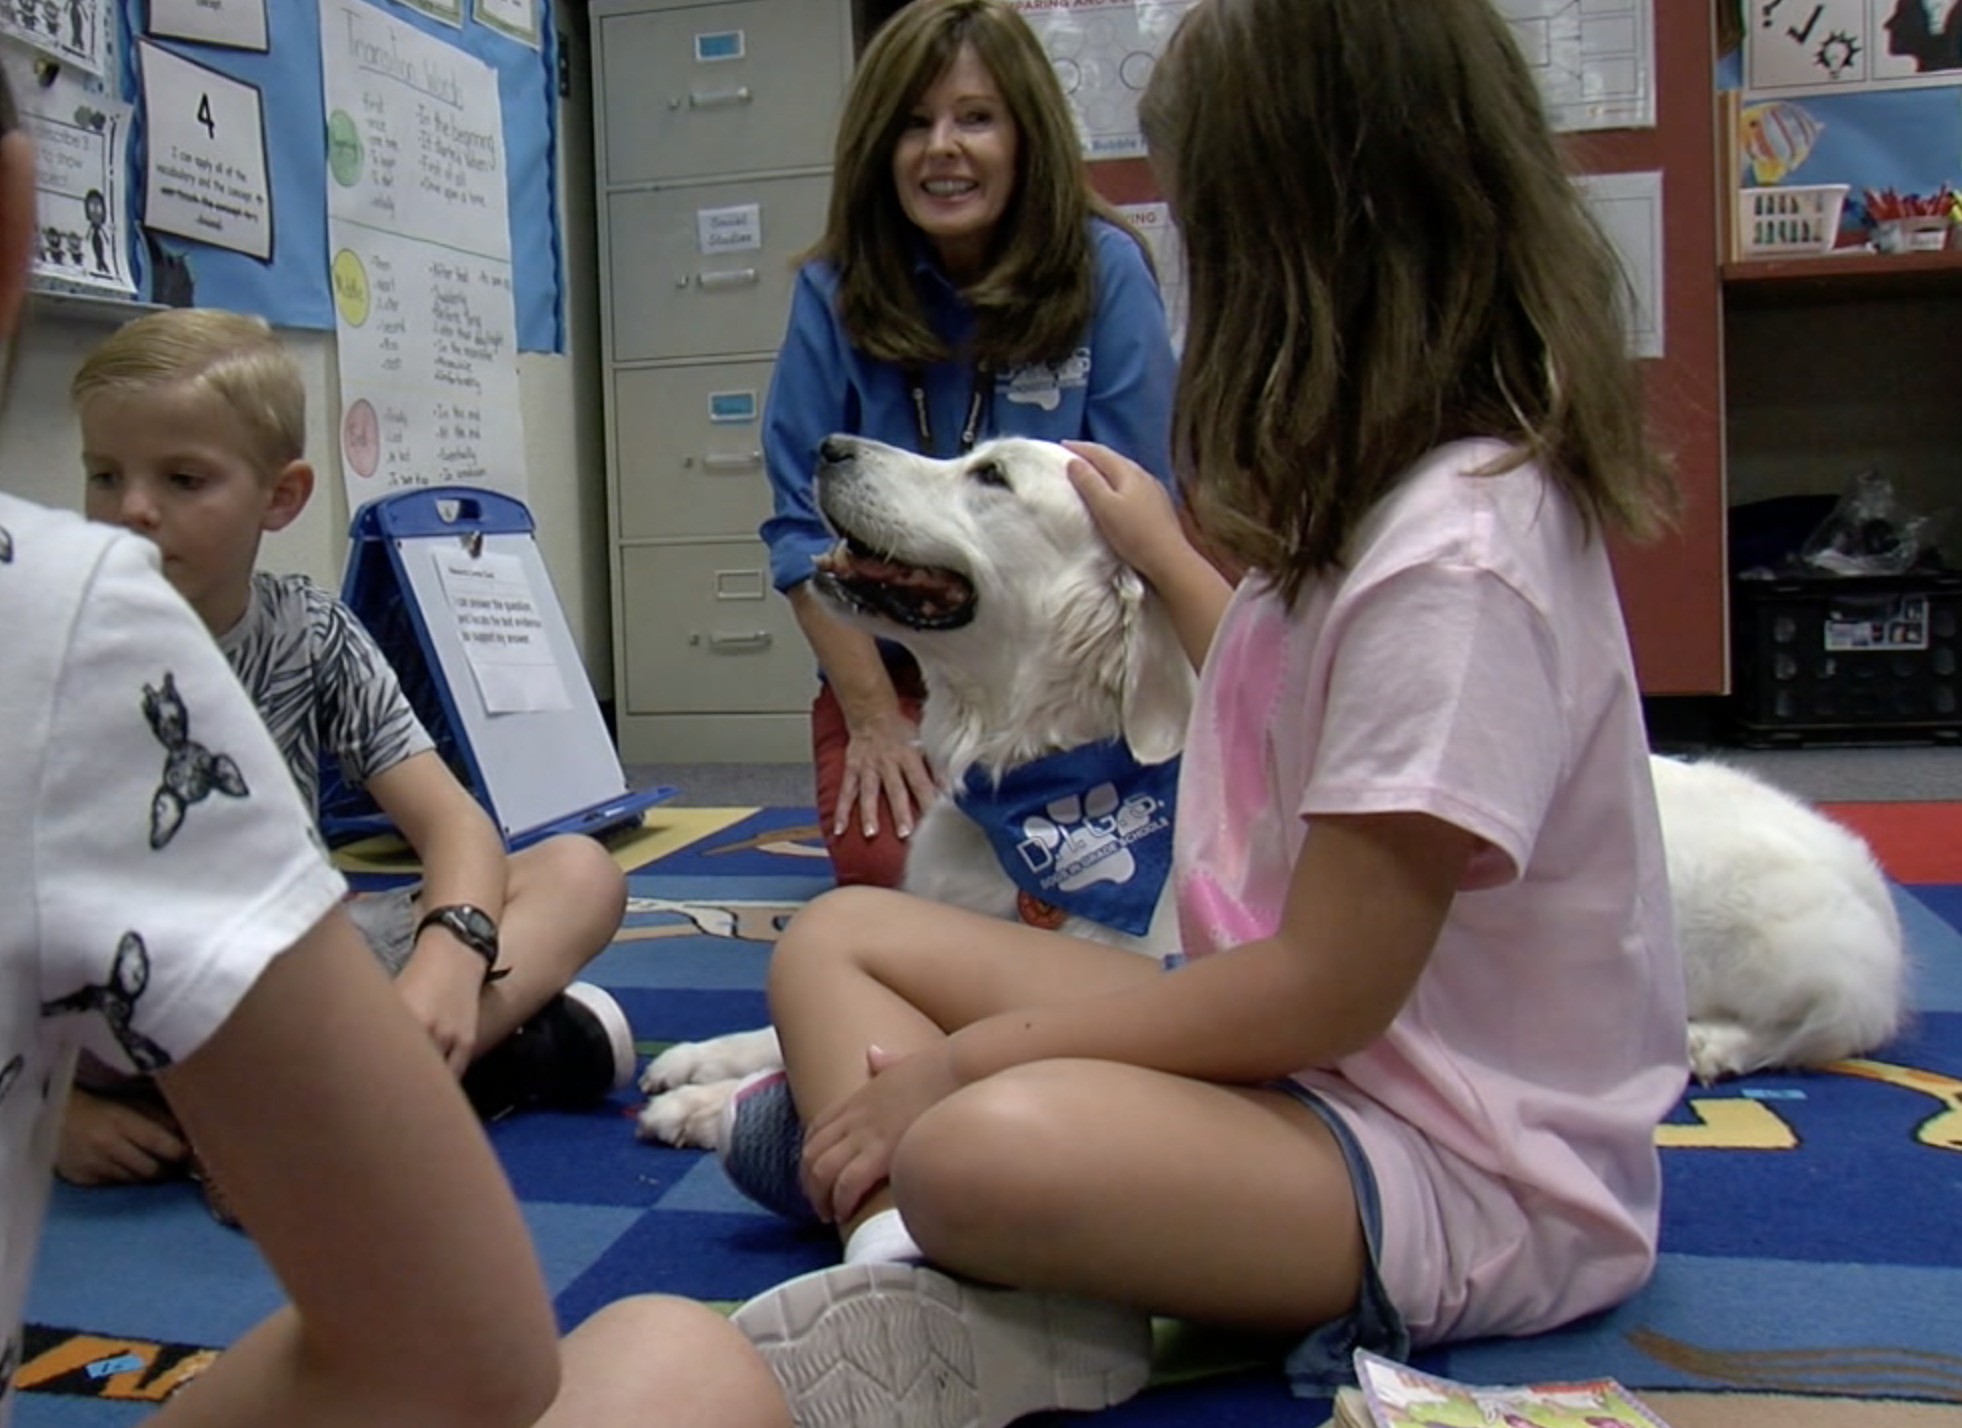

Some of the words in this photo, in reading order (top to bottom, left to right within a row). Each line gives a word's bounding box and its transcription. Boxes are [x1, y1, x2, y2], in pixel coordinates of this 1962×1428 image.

[197, 93, 215, 140] 4
[1091, 138, 1137, 151] Bubble
[708, 212, 749, 228] Social
[708, 231, 753, 247] Studies
[1080, 840, 1122, 869] GRADE
[1118, 816, 1170, 848] SCHOOLS
